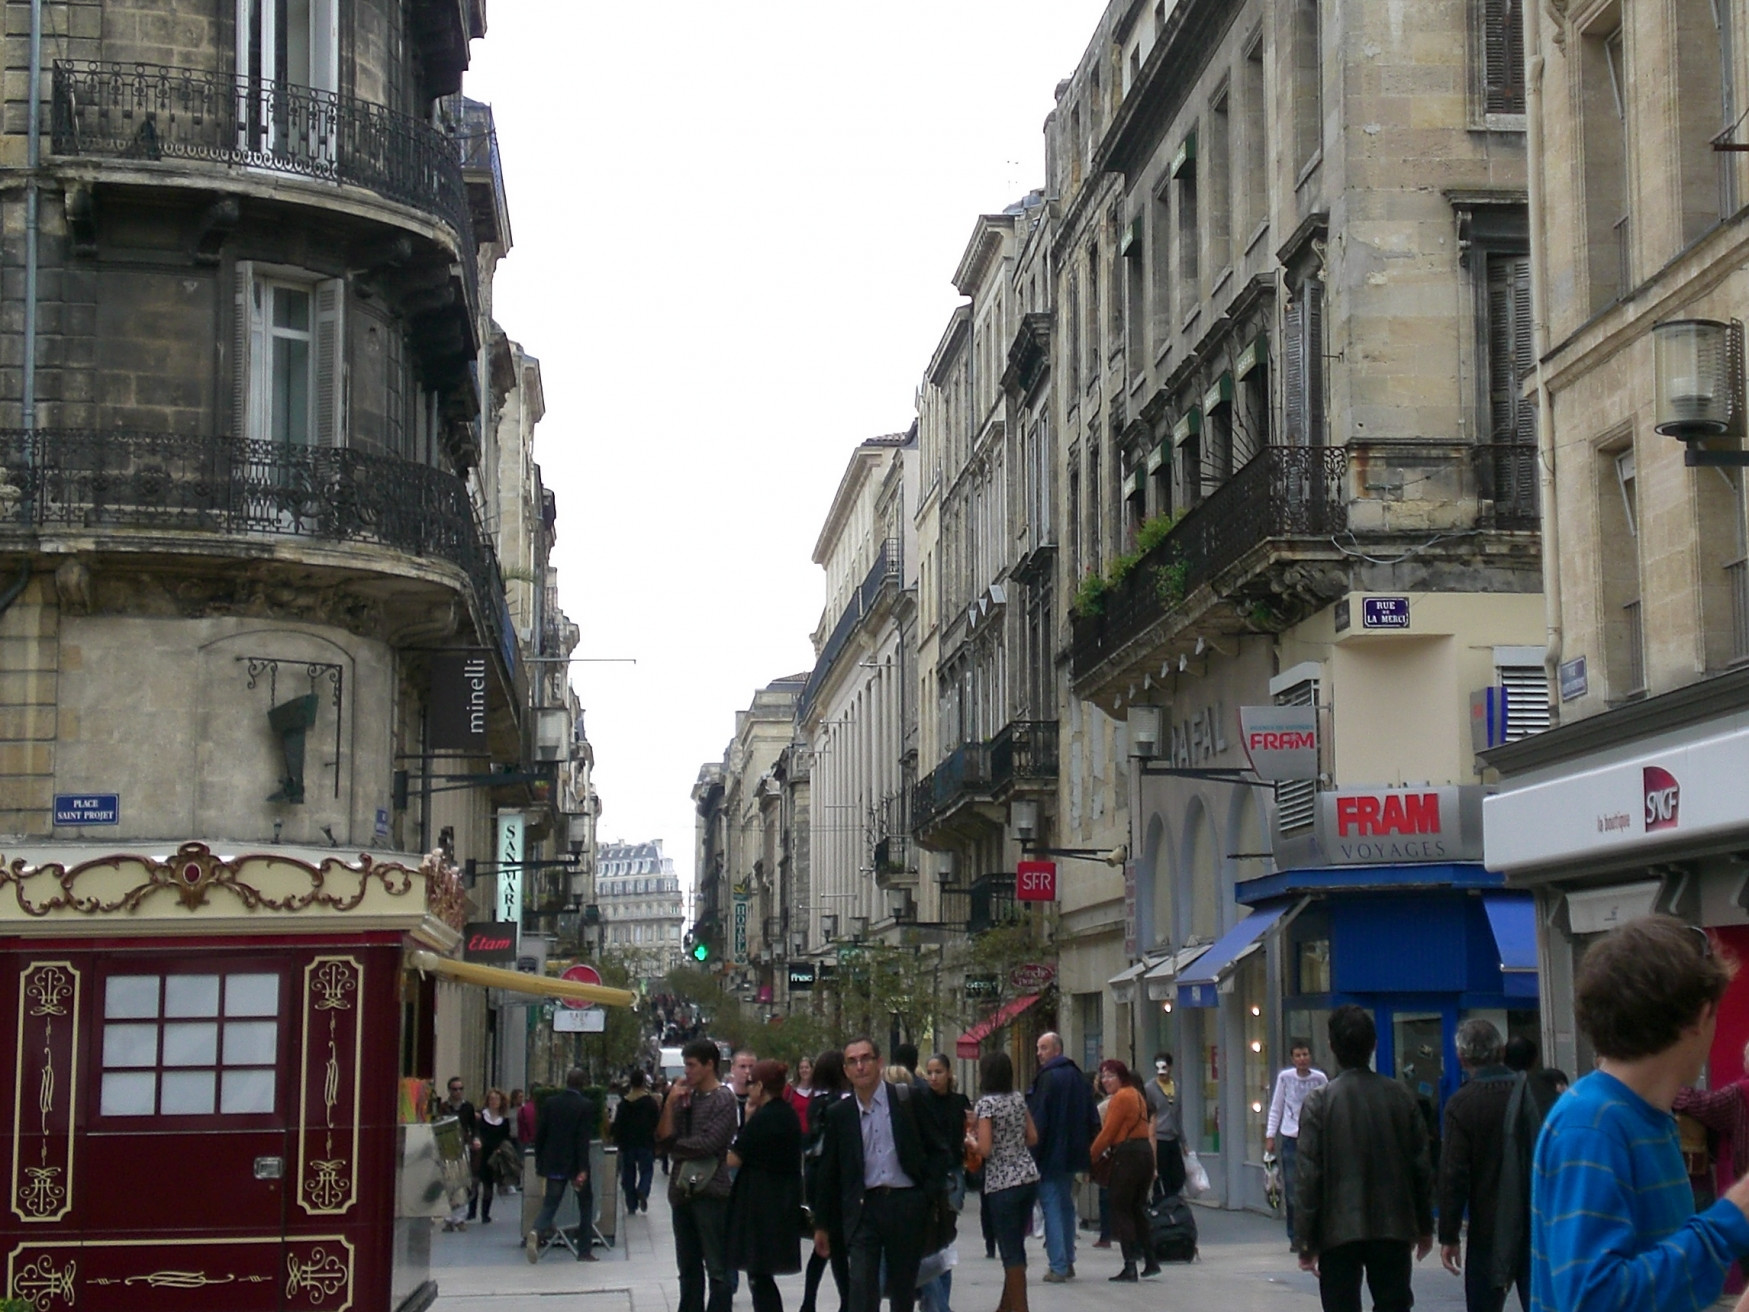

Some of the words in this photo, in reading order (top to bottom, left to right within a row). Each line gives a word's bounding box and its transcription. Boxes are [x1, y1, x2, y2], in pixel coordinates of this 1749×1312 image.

[1376, 601, 1396, 610] RUE
[1367, 615, 1377, 623] LA
[1381, 615, 1406, 624] MERCI
[464, 659, 485, 733] minelli
[1250, 731, 1315, 750] FRAM
[73, 799, 99, 808] PLACE
[1646, 785, 1678, 824] SNCF
[57, 811, 82, 820] SAINT
[84, 811, 114, 821] PROJET
[1336, 793, 1441, 837] FRAM
[1340, 840, 1446, 860] VOYAGES
[1022, 872, 1051, 891] SFR
[735, 902, 746, 954] HOTEL
[468, 934, 511, 951] Etam
[790, 973, 814, 983] fnac
